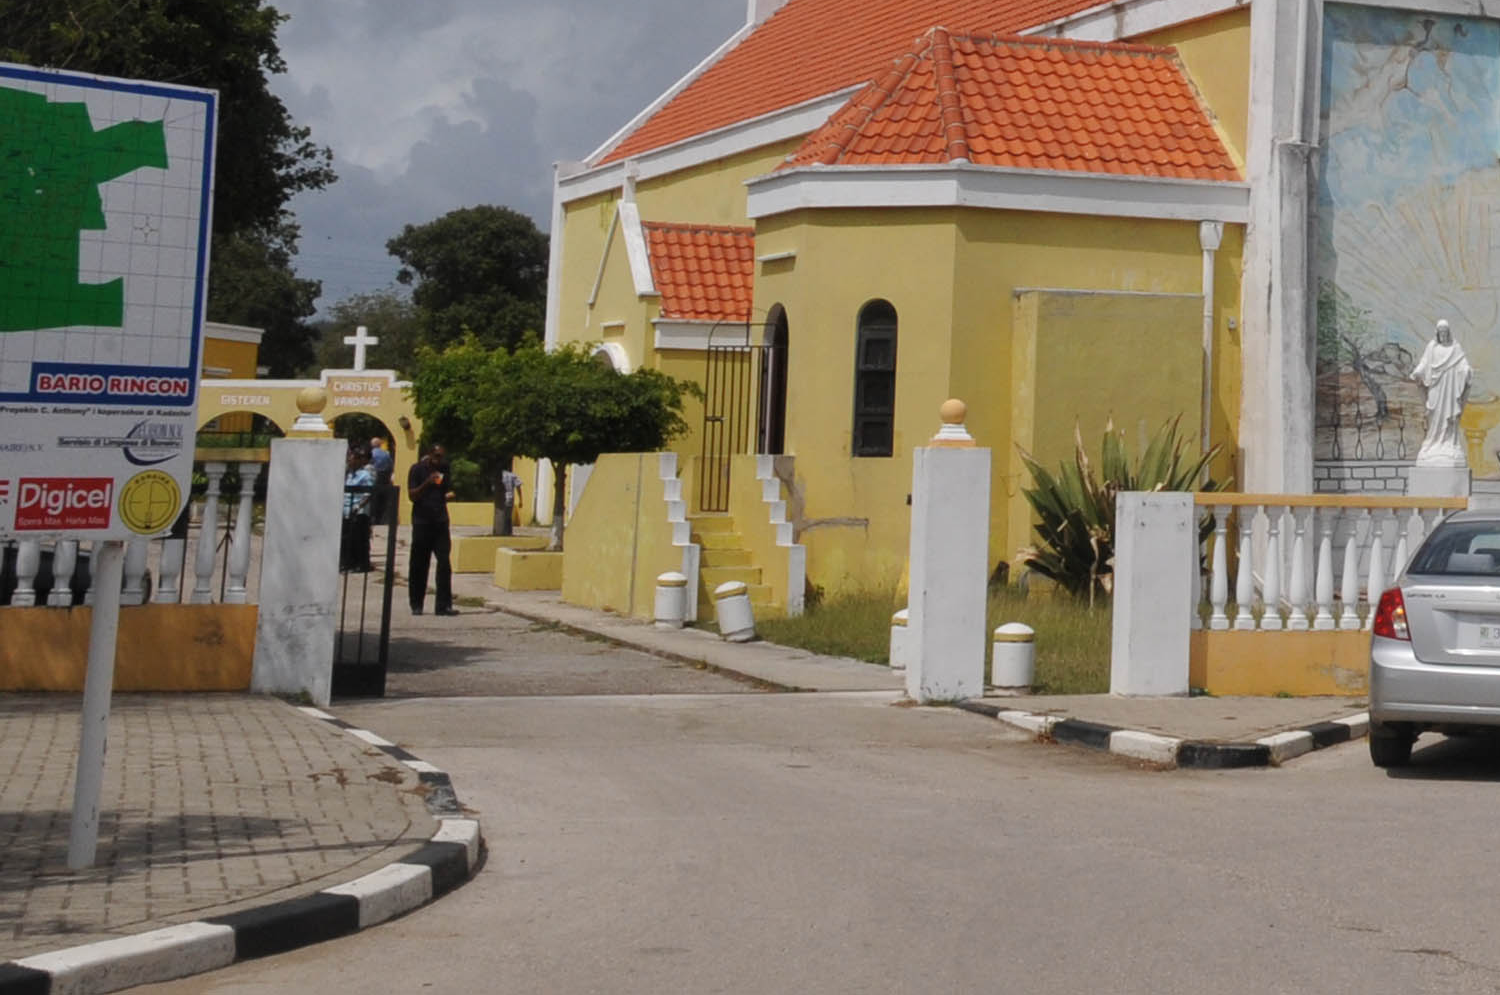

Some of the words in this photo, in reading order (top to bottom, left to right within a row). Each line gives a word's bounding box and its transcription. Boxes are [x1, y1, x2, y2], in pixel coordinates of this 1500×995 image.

[39, 374, 104, 393] BARIO
[107, 376, 189, 396] RINCON
[333, 382, 382, 392] CHRISTUS
[20, 482, 112, 515] Digicel
